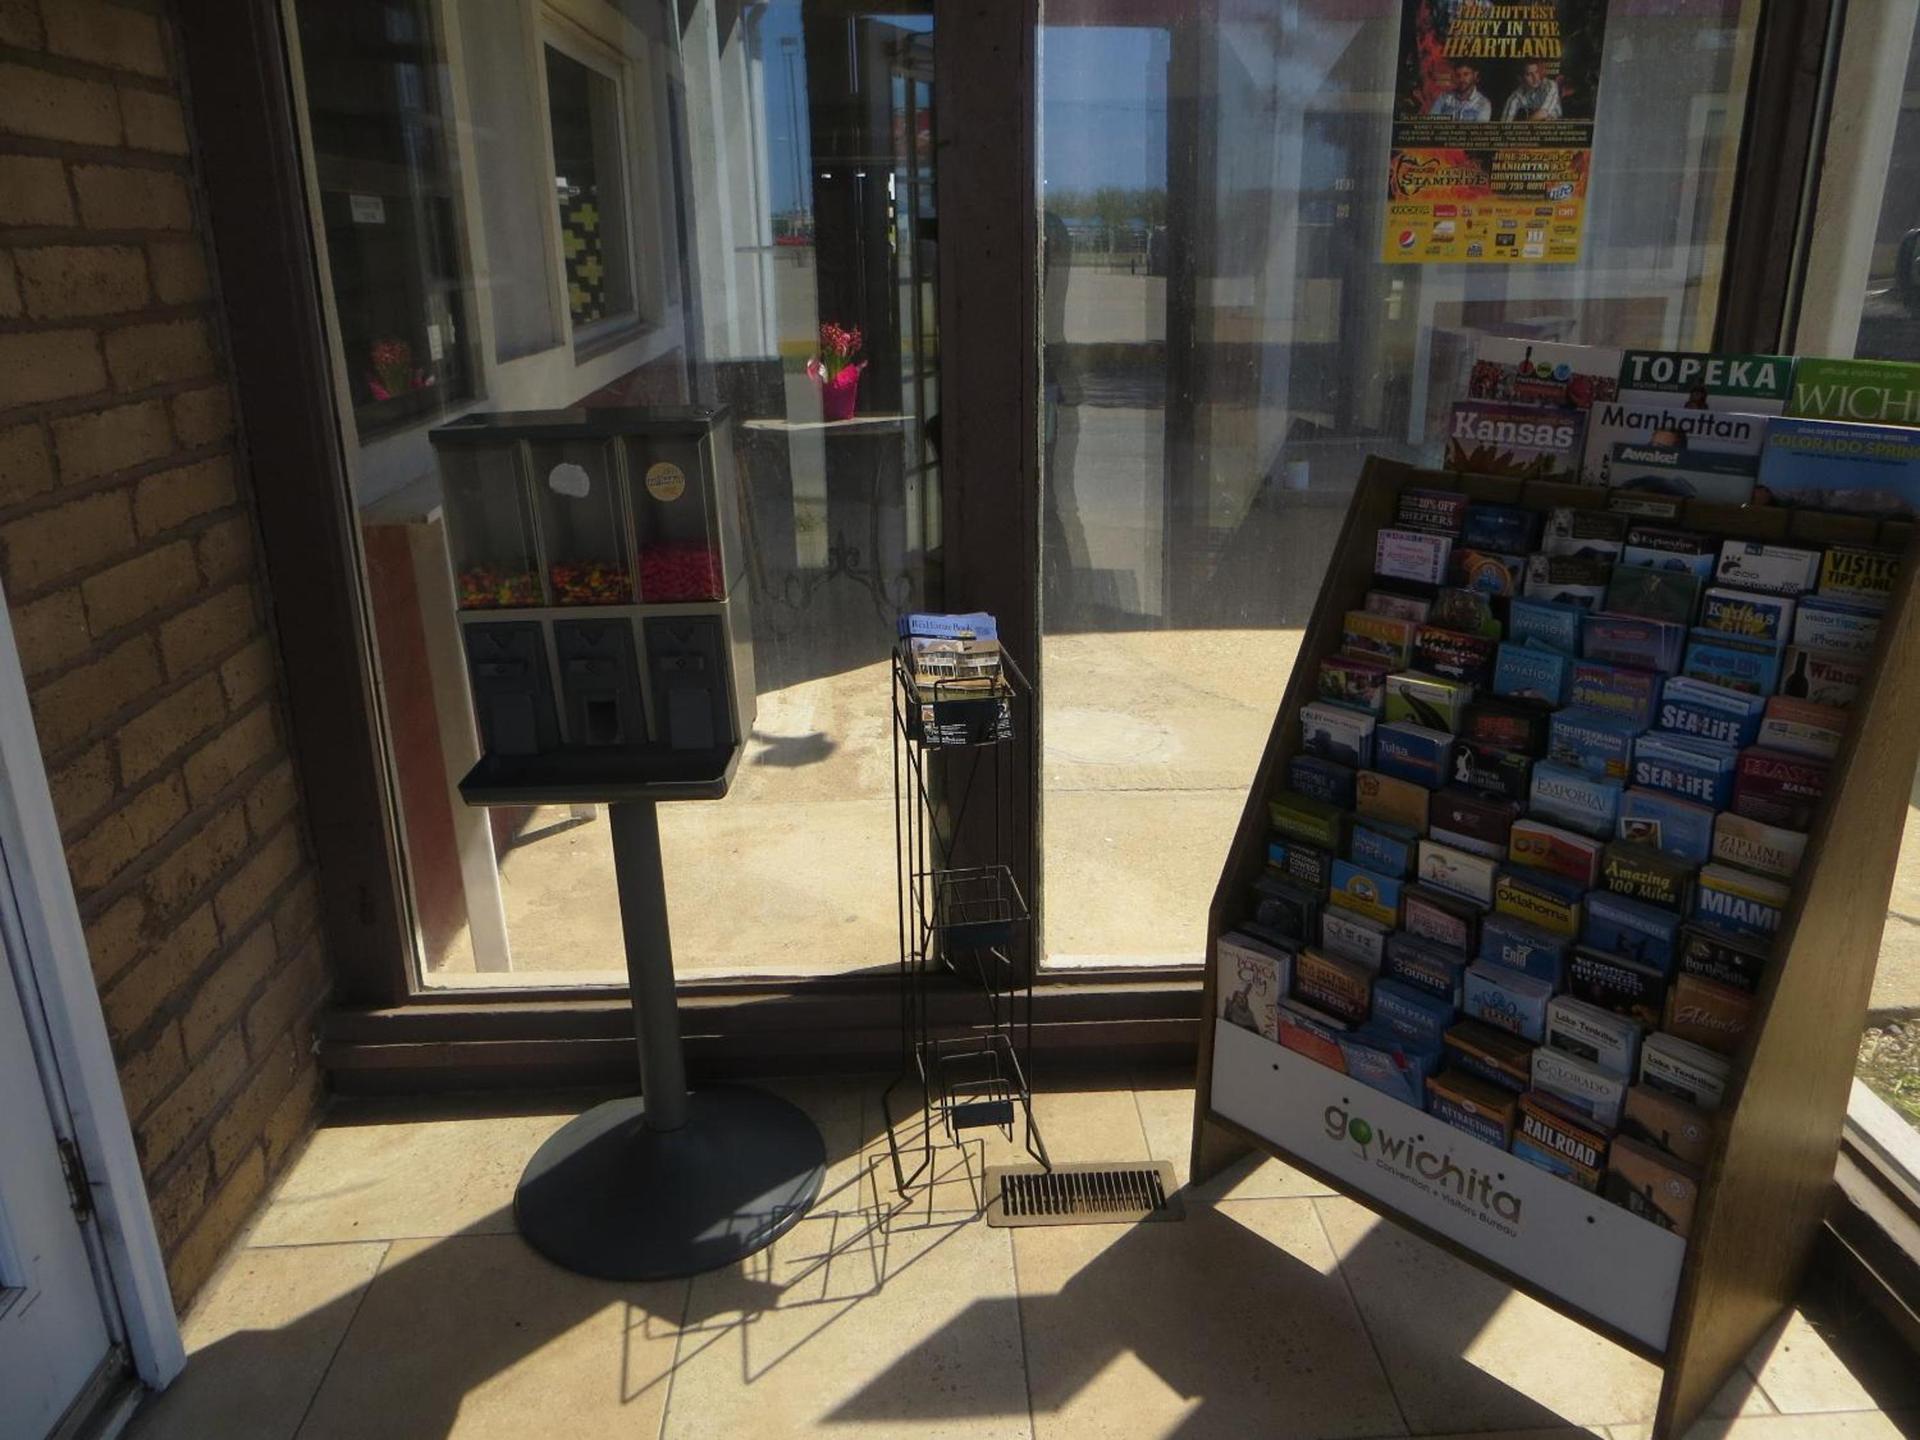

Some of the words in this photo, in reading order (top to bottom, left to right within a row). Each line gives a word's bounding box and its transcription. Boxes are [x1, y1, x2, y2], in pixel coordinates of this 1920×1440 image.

[1490, 5, 1556, 20] HOTTEST
[1447, 20, 1503, 36] PARTY
[1506, 20, 1524, 36] IN
[1528, 20, 1560, 37] THE
[1442, 37, 1562, 59] HEARTLAND
[1401, 173, 1488, 187] STAMPEDE
[1631, 356, 1777, 390] TOPEKA
[1452, 411, 1575, 449] Kansas
[1601, 404, 1751, 440] Manhattan
[1769, 432, 1863, 454] COLORADO
[1620, 447, 1680, 465] Awake!
[1827, 570, 1857, 587] TIPS
[1379, 740, 1409, 757] Tulsa
[1604, 860, 1671, 891] Amazing
[1608, 878, 1634, 895] 100
[1700, 887, 1782, 931] MIAMI
[1522, 1114, 1597, 1168] RAILROAD
[1479, 1212, 1518, 1238] Bureau
